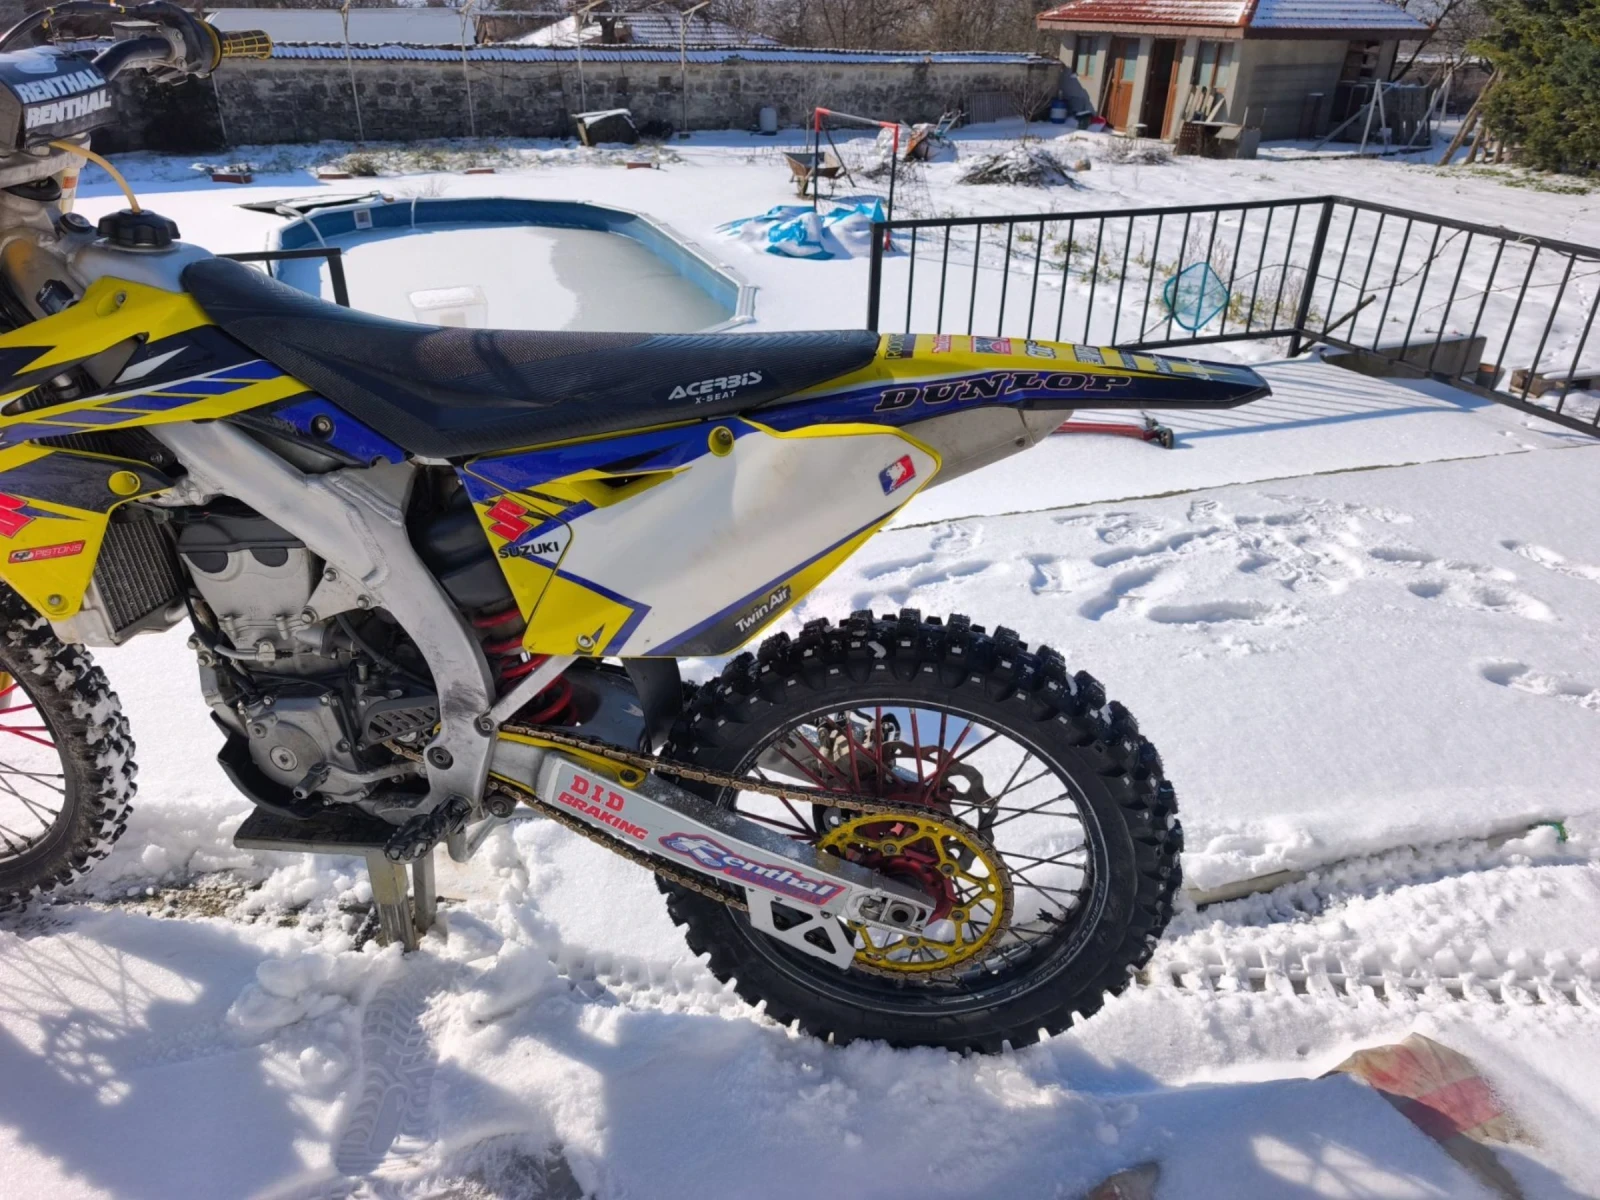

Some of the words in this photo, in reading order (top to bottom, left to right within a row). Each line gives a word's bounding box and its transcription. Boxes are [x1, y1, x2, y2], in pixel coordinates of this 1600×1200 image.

[13, 68, 106, 104] RENTHAL
[26, 89, 112, 129] RENTHAL
[695, 390, 737, 404] X-SEAT
[873, 371, 1132, 412] DUNLOP
[35, 543, 82, 557] PISTONS
[498, 541, 559, 559] SUZUKI
[735, 605, 769, 632] Twin
[769, 587, 789, 610] Air
[558, 791, 649, 840] BRAKING
[666, 836, 834, 896] Renthal
